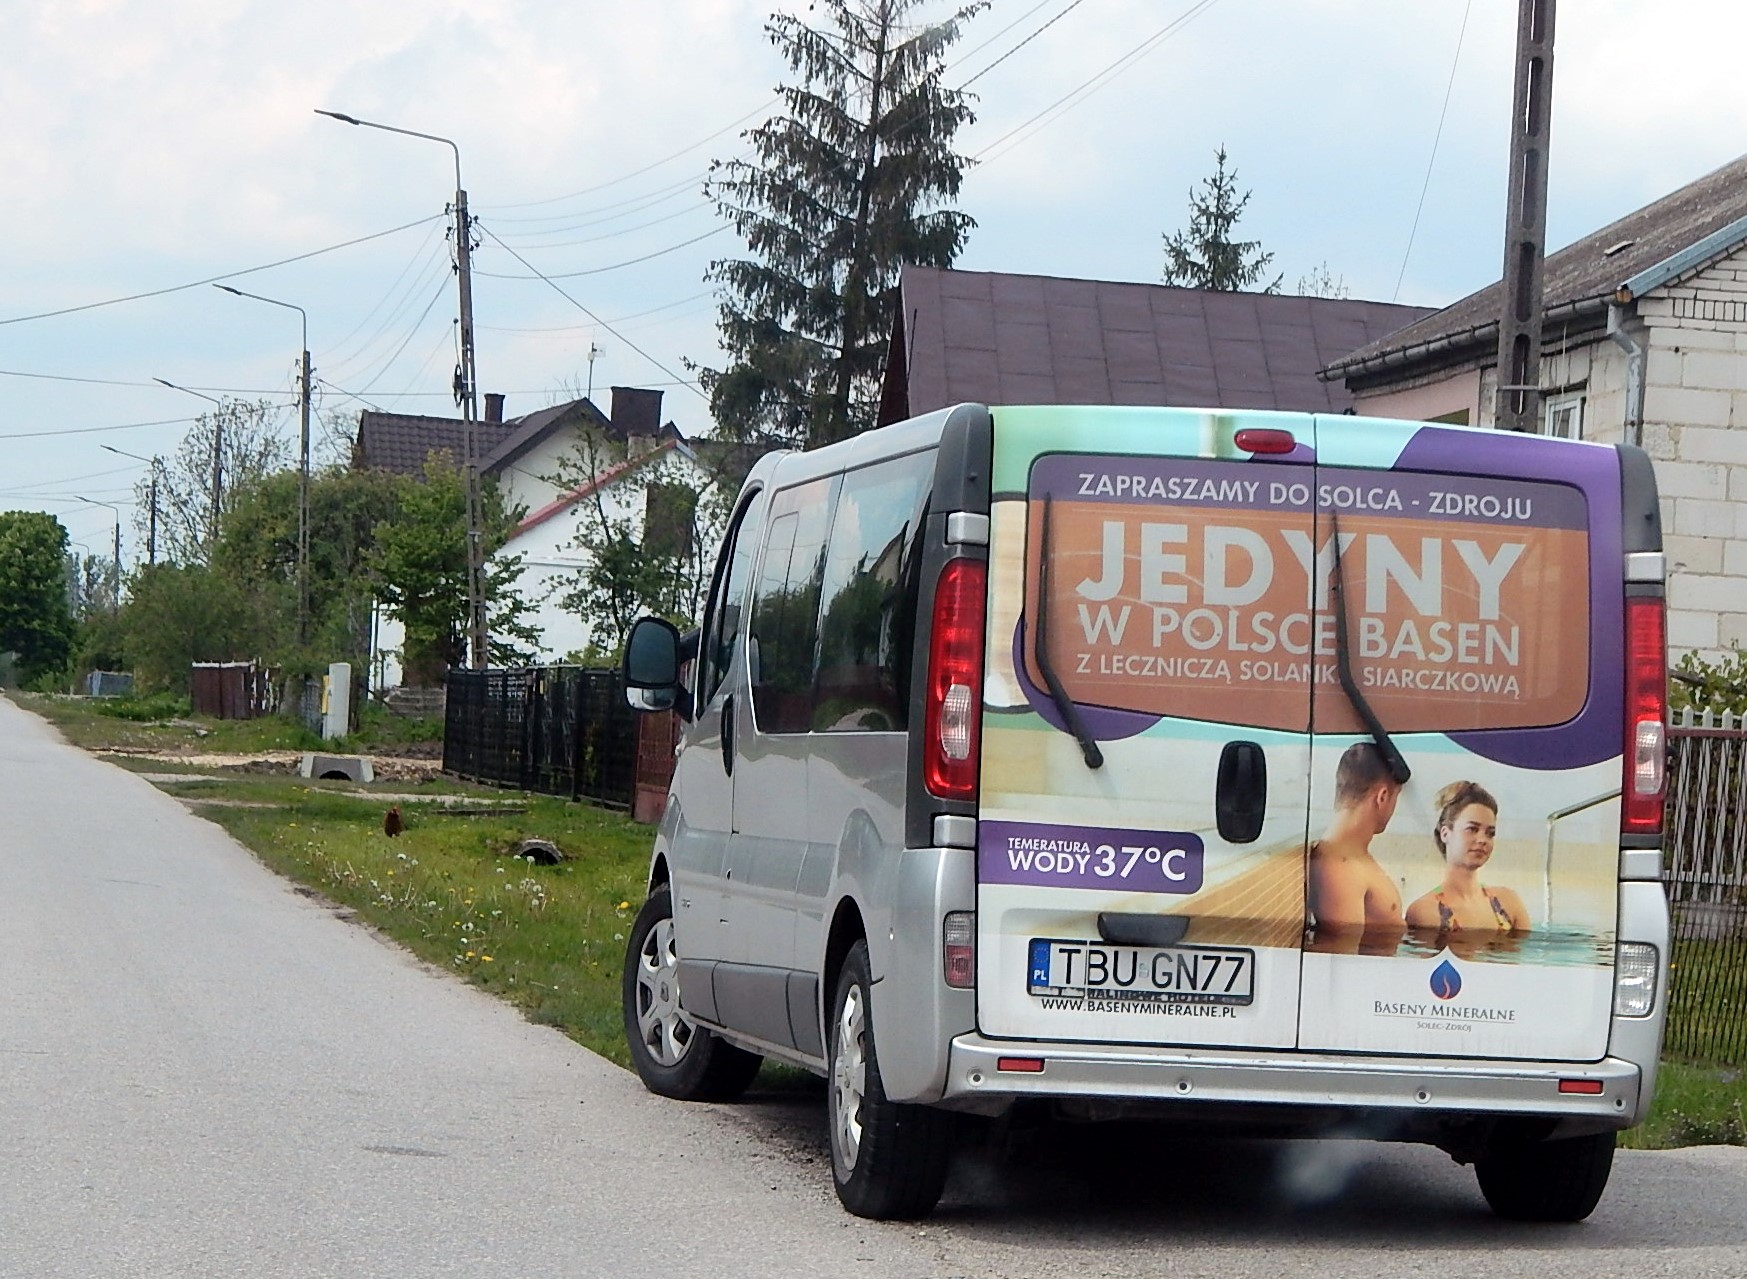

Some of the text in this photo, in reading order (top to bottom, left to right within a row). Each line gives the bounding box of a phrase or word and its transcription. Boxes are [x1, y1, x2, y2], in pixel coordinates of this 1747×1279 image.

[1078, 473, 1261, 506] ZAPRASZAMY
[1269, 483, 1309, 506] DO
[1318, 485, 1403, 511] SOLCA
[1429, 492, 1533, 520] ZDROJU
[1075, 520, 1527, 621] JEDYNY
[1076, 603, 1520, 667] W POLSCE BASEN
[1075, 654, 1521, 699] Z LECZNICZĄ SOLANK SIARCZKOWĄ
[1008, 837, 1090, 853] TEMERATURA
[1008, 849, 1091, 875] WODY
[1033, 969, 1047, 981] PL
[1058, 948, 1246, 993] TBU GN77
[1041, 998, 1237, 1019] WWW.BASENYMINERALNE.PL
